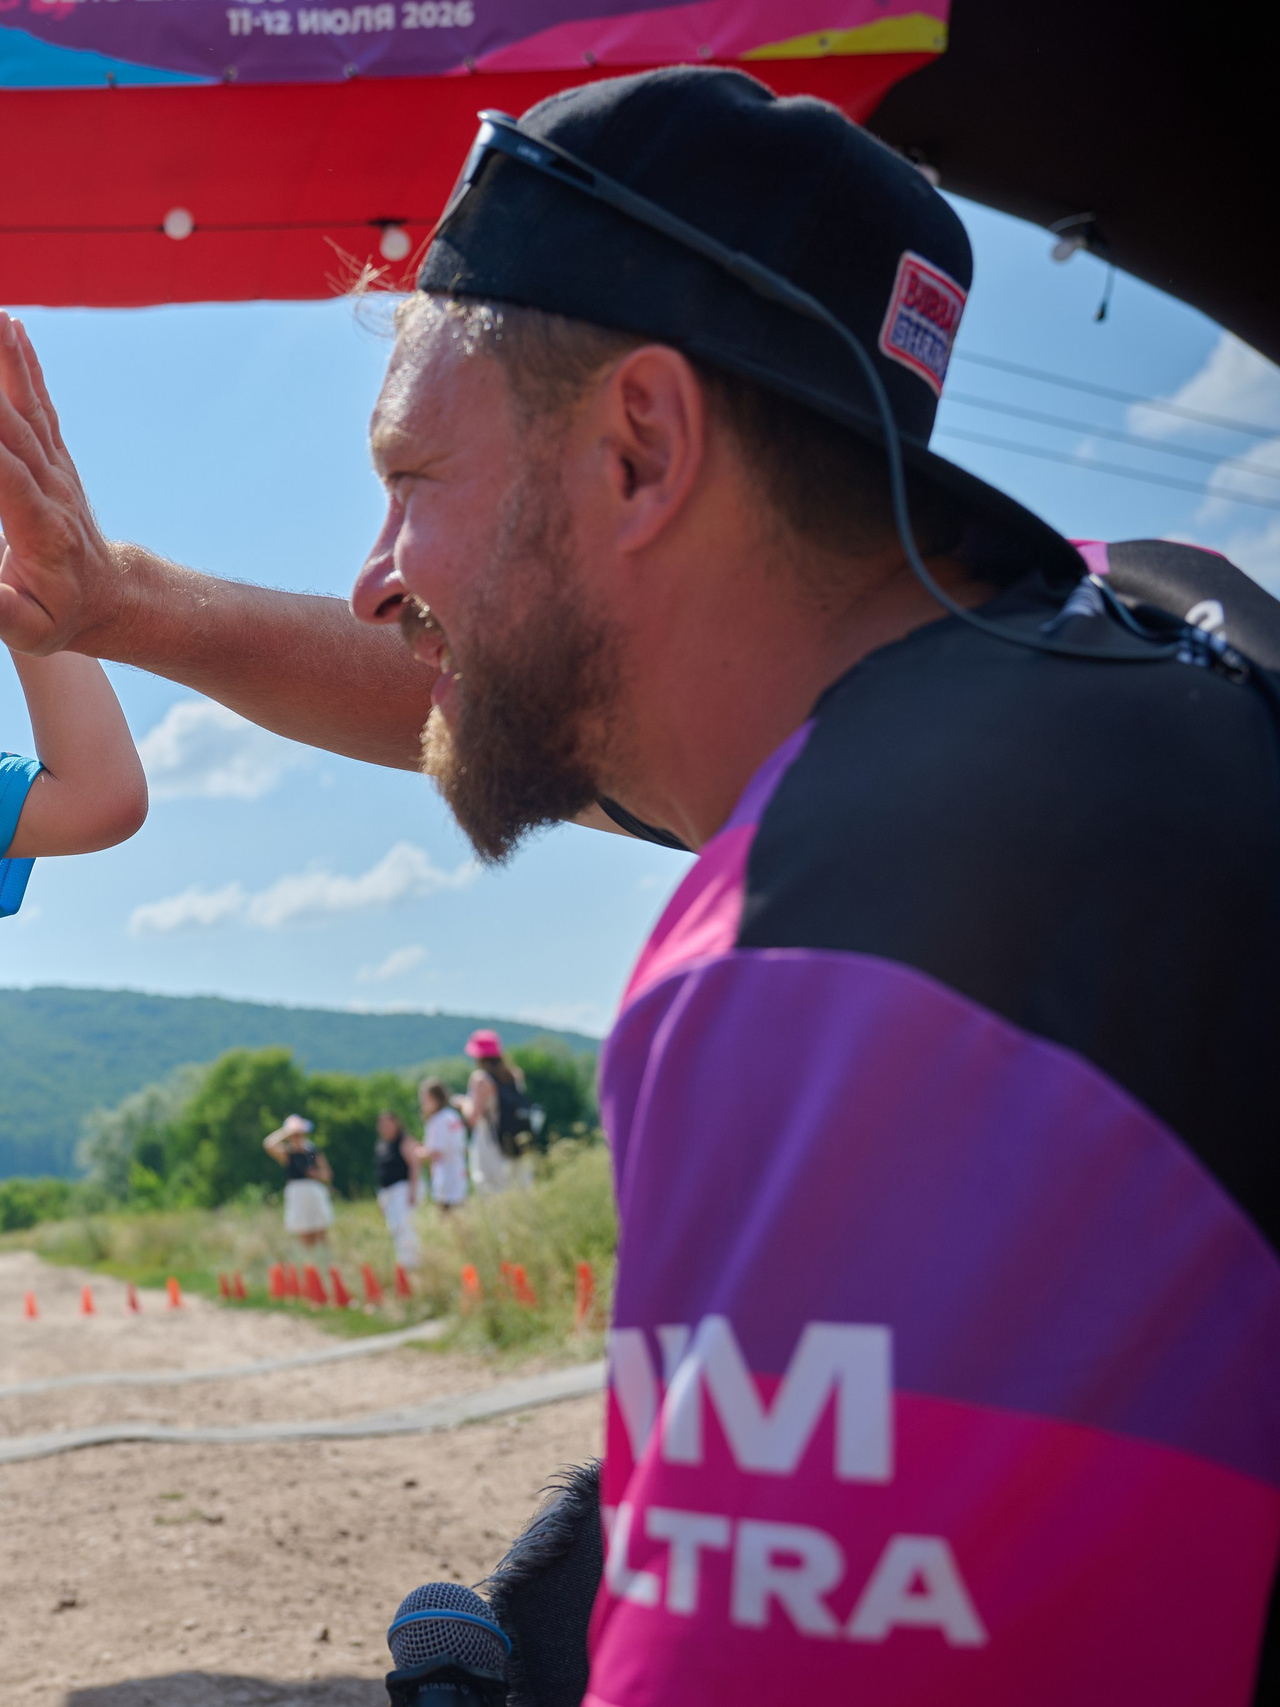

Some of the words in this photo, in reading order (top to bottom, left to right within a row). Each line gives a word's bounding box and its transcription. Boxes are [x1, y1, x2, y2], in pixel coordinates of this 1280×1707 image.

[297, 4, 395, 35] ИЮЛЯ
[401, 1, 475, 29] 2026
[602, 1500, 990, 1649] LTRA
